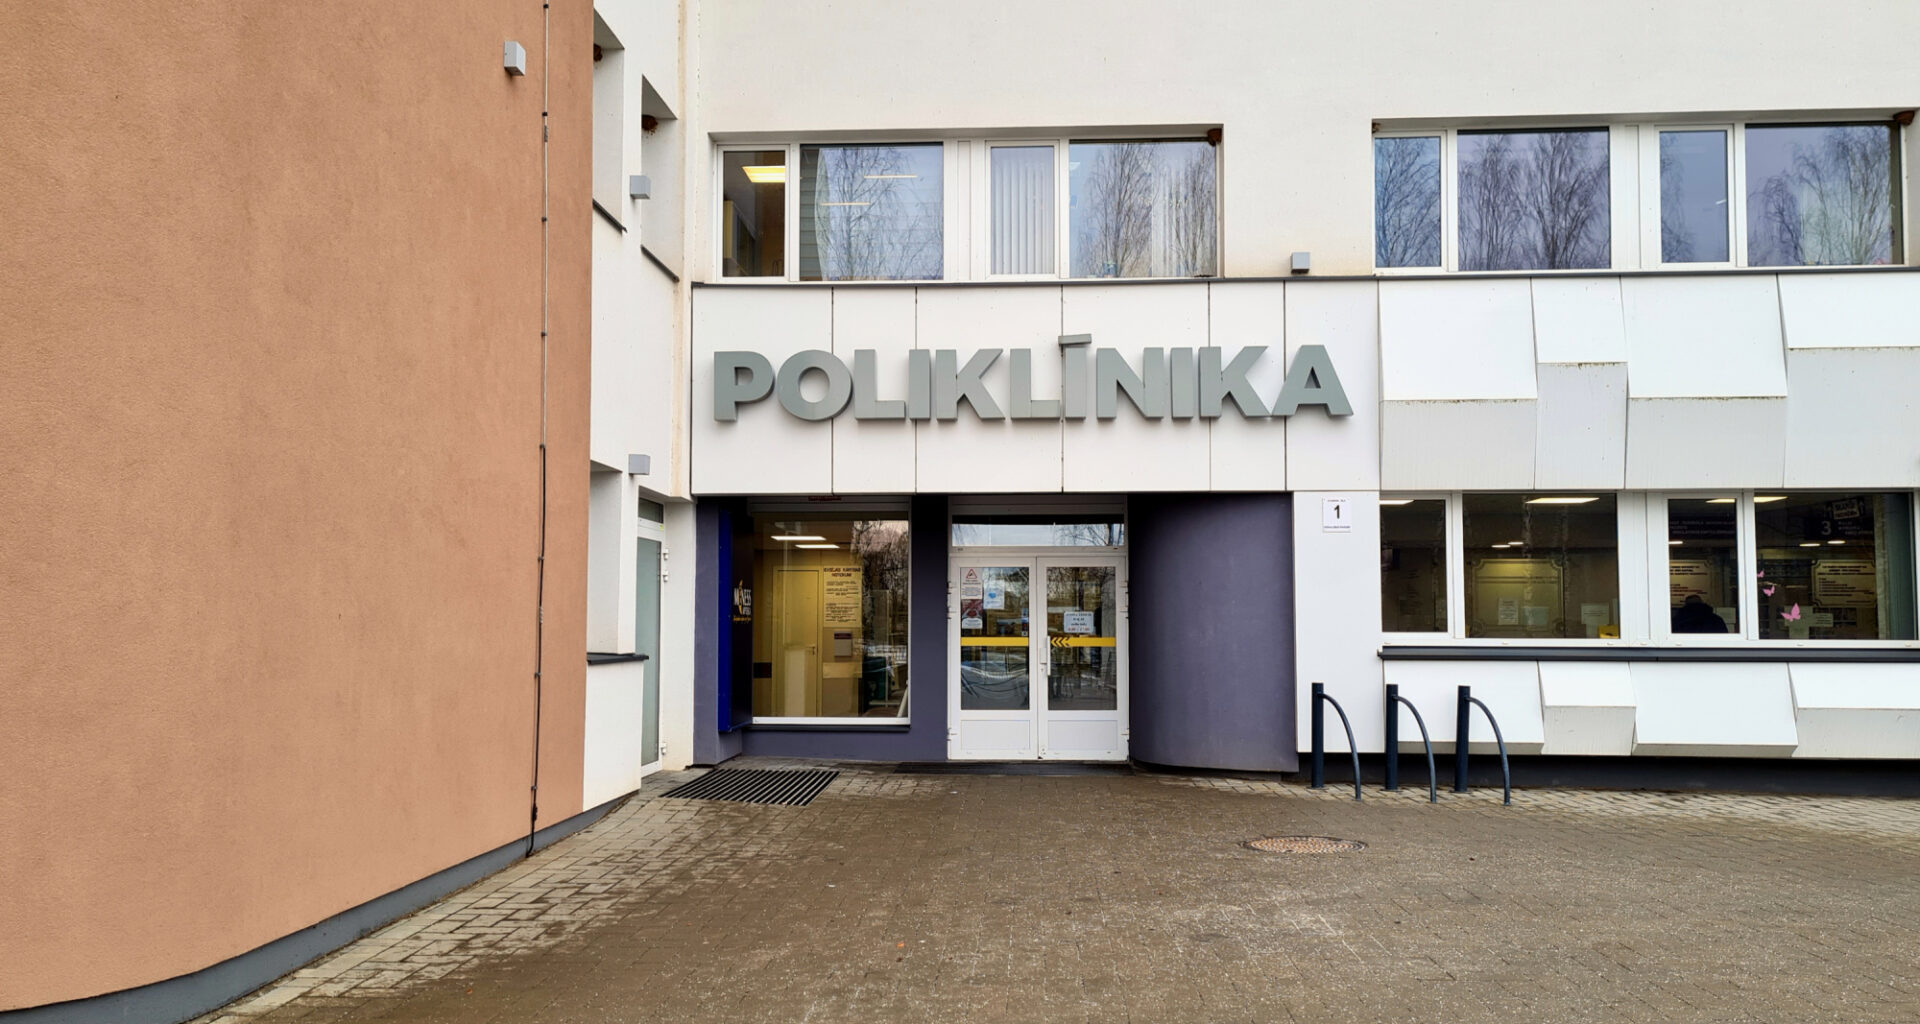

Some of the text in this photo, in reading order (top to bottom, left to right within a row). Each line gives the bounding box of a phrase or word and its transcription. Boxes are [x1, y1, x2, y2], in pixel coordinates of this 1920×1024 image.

[713, 333, 1354, 424] POLIKLĪNIKA
[1334, 504, 1340, 520] 1
[1821, 520, 1832, 536] 3
